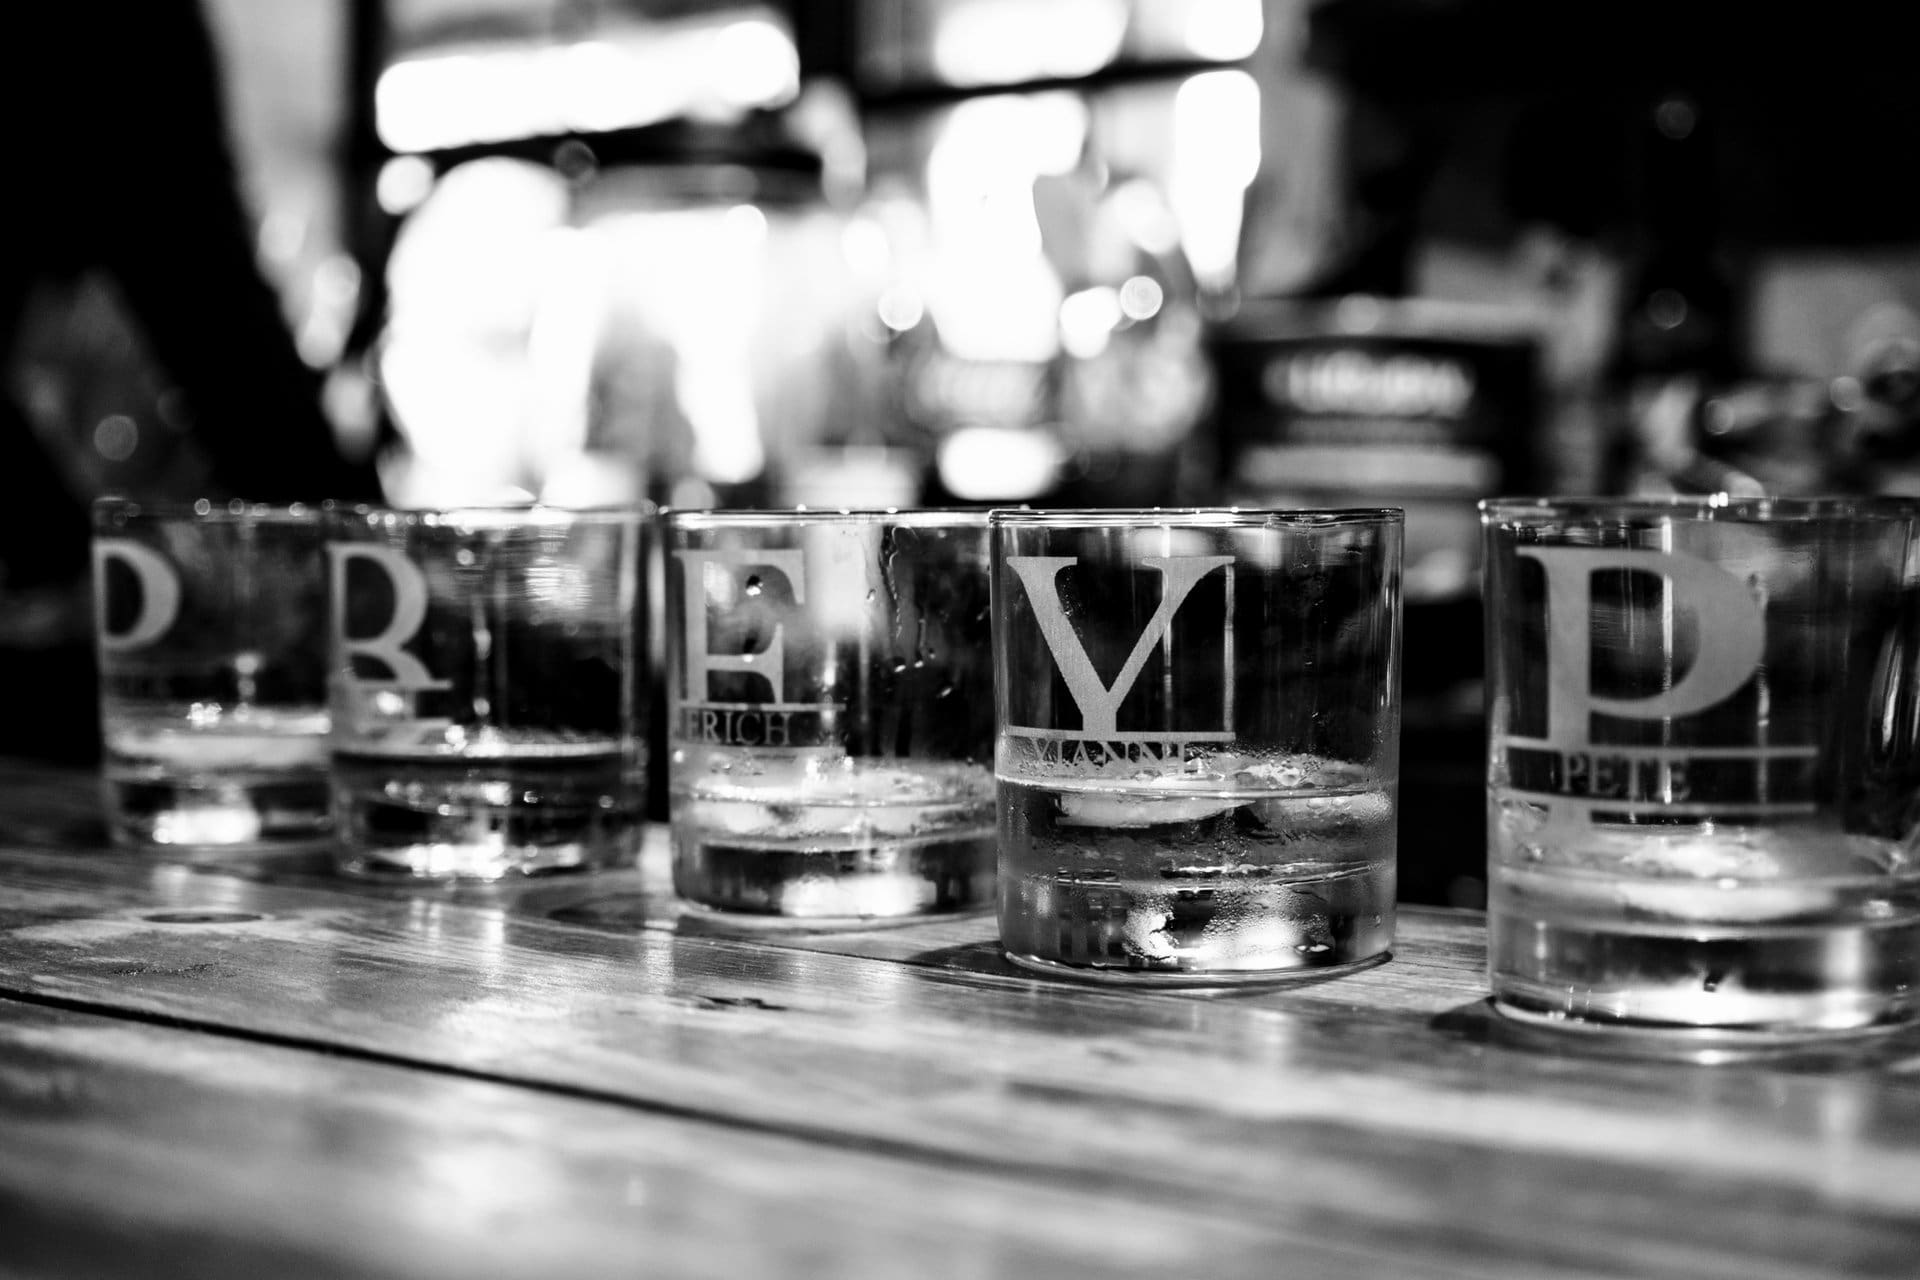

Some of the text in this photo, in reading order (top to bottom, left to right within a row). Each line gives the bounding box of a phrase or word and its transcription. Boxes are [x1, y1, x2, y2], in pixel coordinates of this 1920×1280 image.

[326, 542, 452, 688] R
[672, 549, 805, 704] E
[1006, 556, 1235, 737] Y
[1516, 546, 1768, 750] P
[685, 711, 793, 745] ERICH
[1560, 752, 1692, 800] PETE
